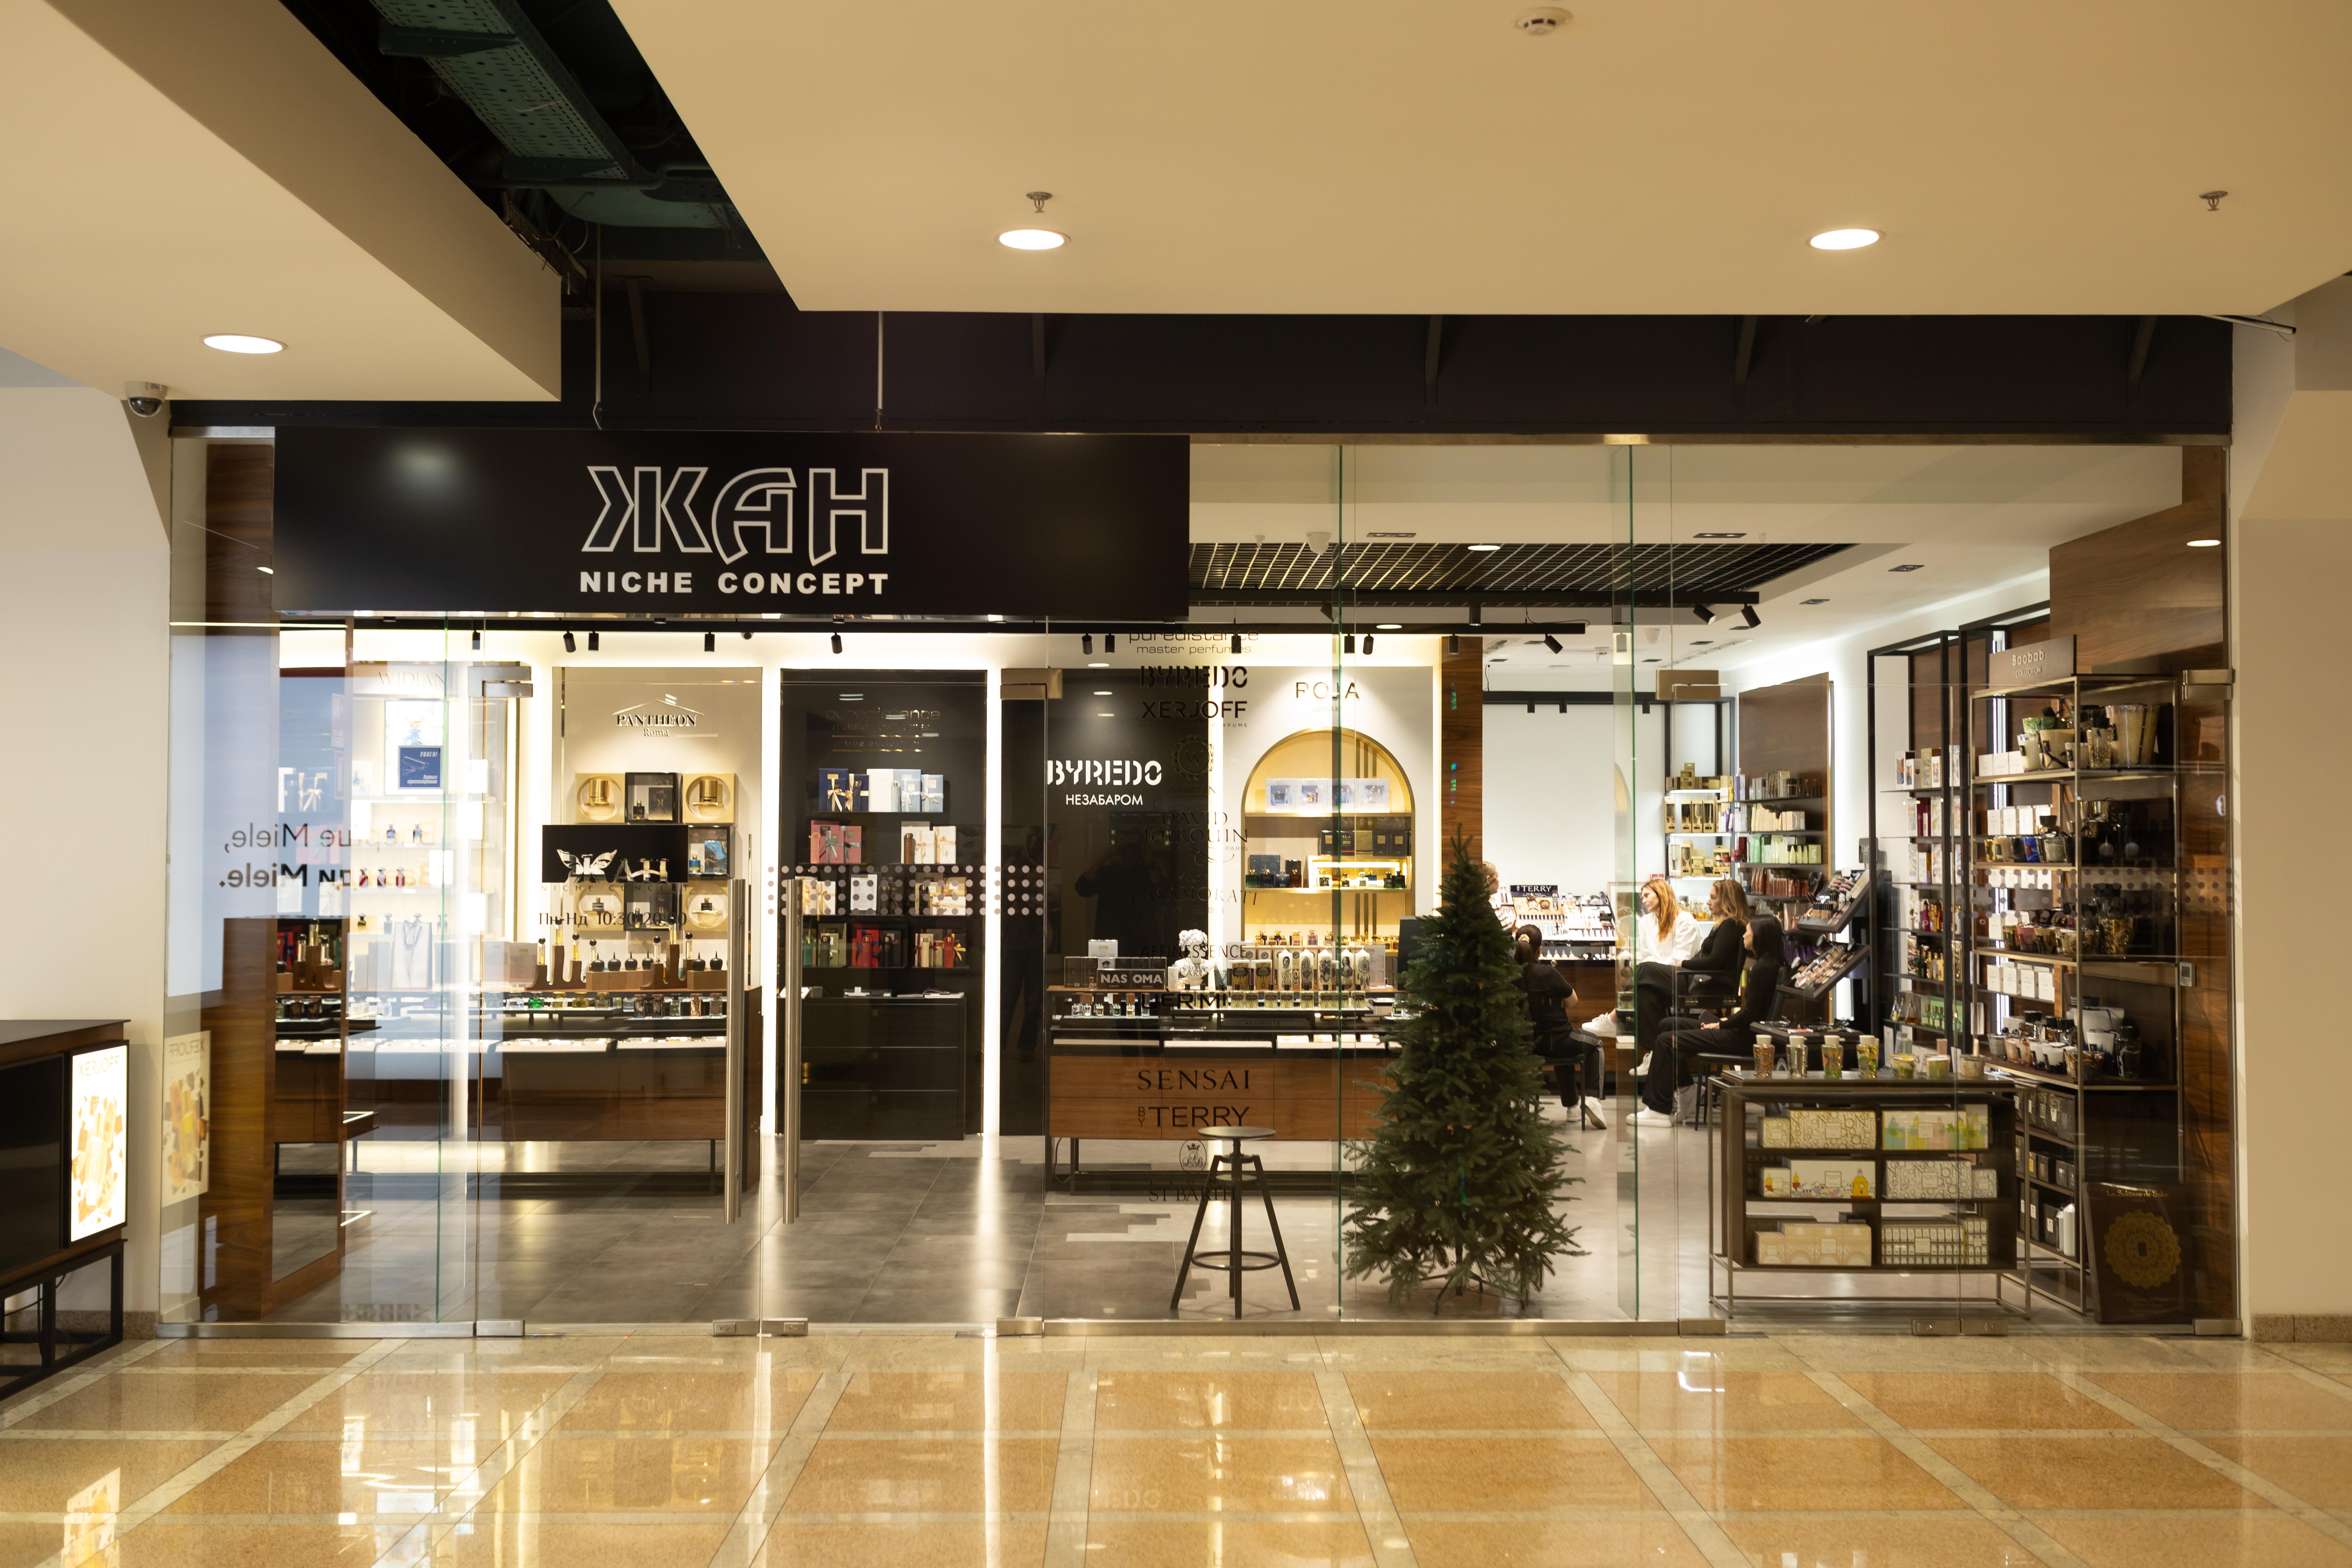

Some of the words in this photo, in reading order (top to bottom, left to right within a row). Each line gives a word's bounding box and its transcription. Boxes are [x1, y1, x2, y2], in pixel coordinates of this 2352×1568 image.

[581, 466, 889, 567] ЖАН
[580, 572, 692, 593] NICHE
[718, 572, 889, 595] CONCEPT
[1129, 629, 1259, 644] puredistance
[1137, 645, 1184, 654] master
[2013, 649, 2044, 666] Baobab
[379, 671, 447, 687] WIDIAN
[1140, 665, 1248, 688] BYREDO
[1296, 682, 1359, 699] ROJA
[1141, 700, 1248, 719] XERJOFF
[616, 714, 697, 727] PANTHEON
[644, 728, 670, 737] Roma
[1047, 760, 1162, 786] BYREDO
[1066, 794, 1143, 806] НЕЗАБАРОМ
[1162, 811, 1228, 826] DAVID
[1129, 886, 1257, 905] CASAMORATI
[597, 912, 687, 925] 10:3020:00
[1140, 944, 1247, 958] AFFINESSENCE
[1101, 974, 1127, 983] NAS
[1133, 974, 1163, 983] OMA
[1137, 1070, 1250, 1090] SENSAI
[1138, 1107, 1145, 1127] BY
[1148, 1106, 1250, 1127] TERRY
[1149, 1188, 1167, 1201] ST
